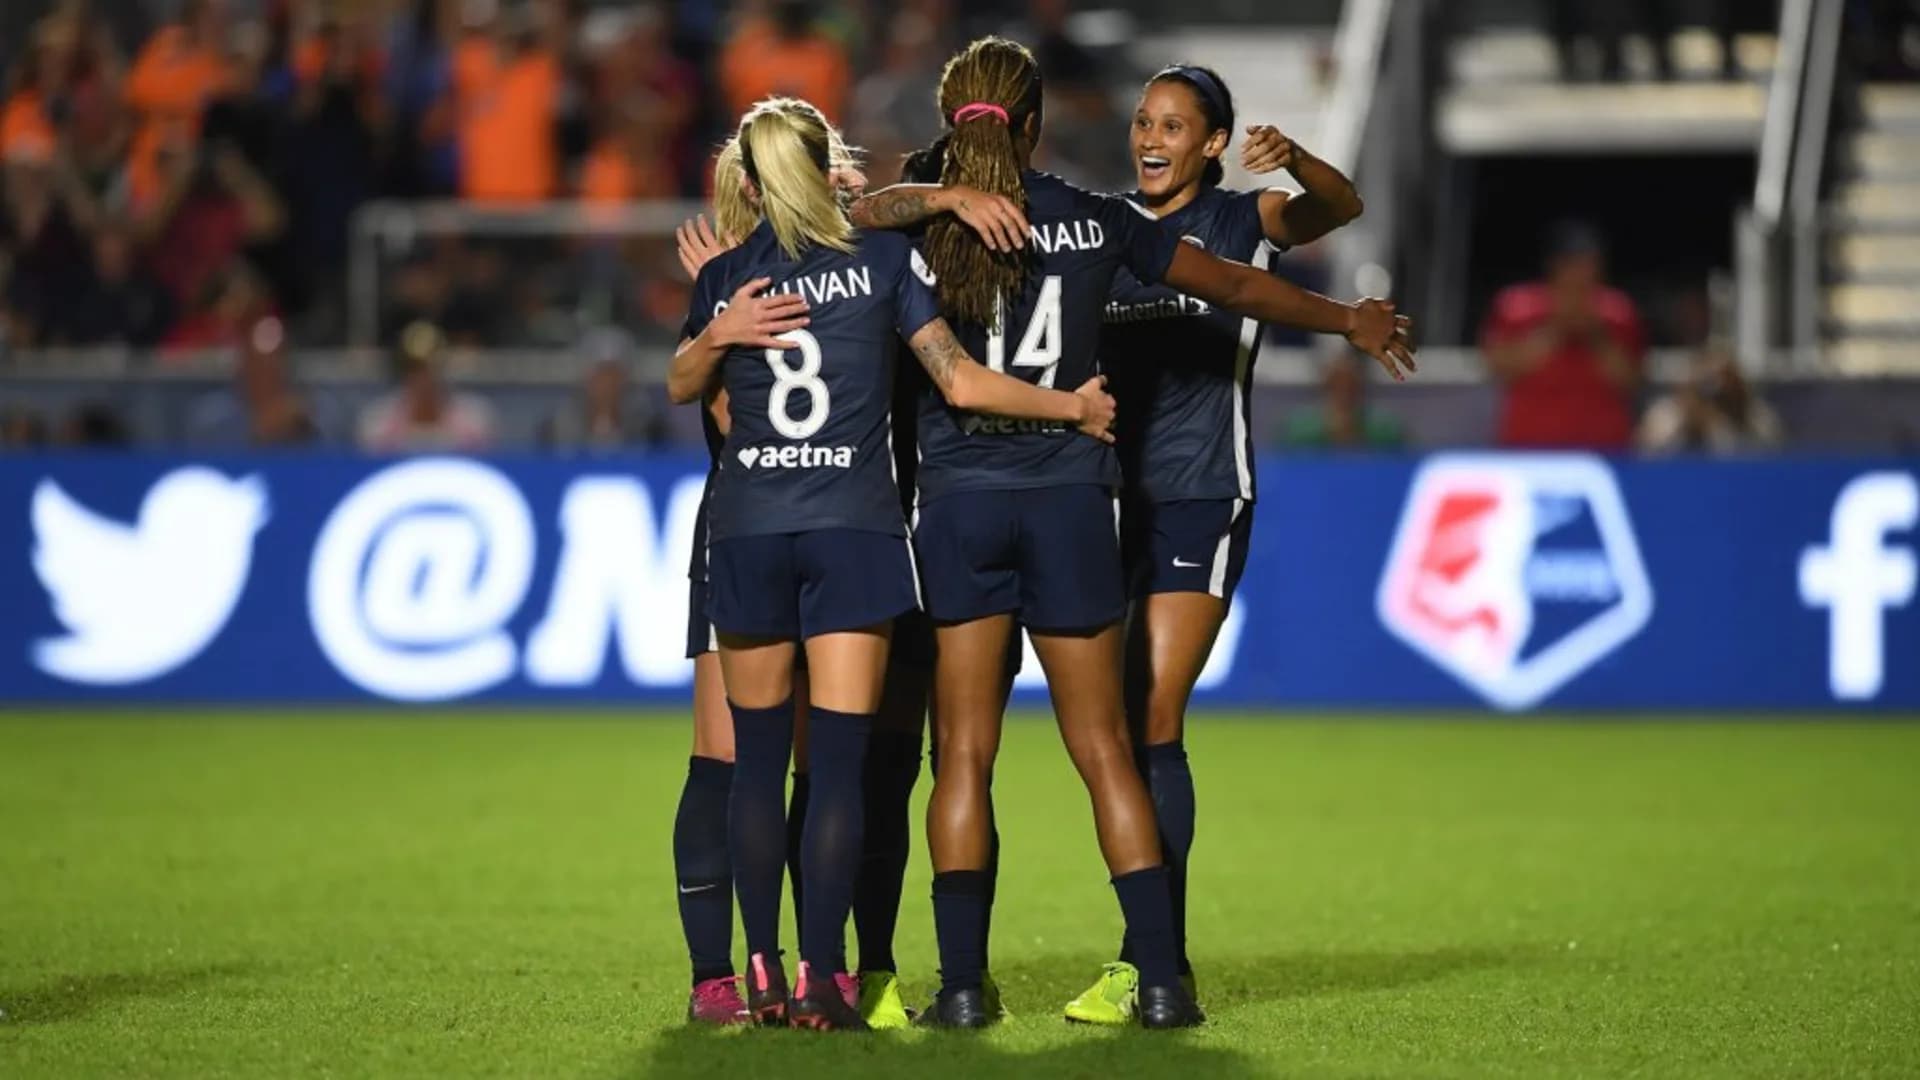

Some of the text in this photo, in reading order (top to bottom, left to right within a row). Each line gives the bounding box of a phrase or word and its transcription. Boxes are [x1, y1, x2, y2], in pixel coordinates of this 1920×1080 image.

[1030, 219, 1104, 253] NALD
[985, 275, 1062, 390] 14
[765, 328, 830, 439] 8
[760, 442, 851, 468] aetna
